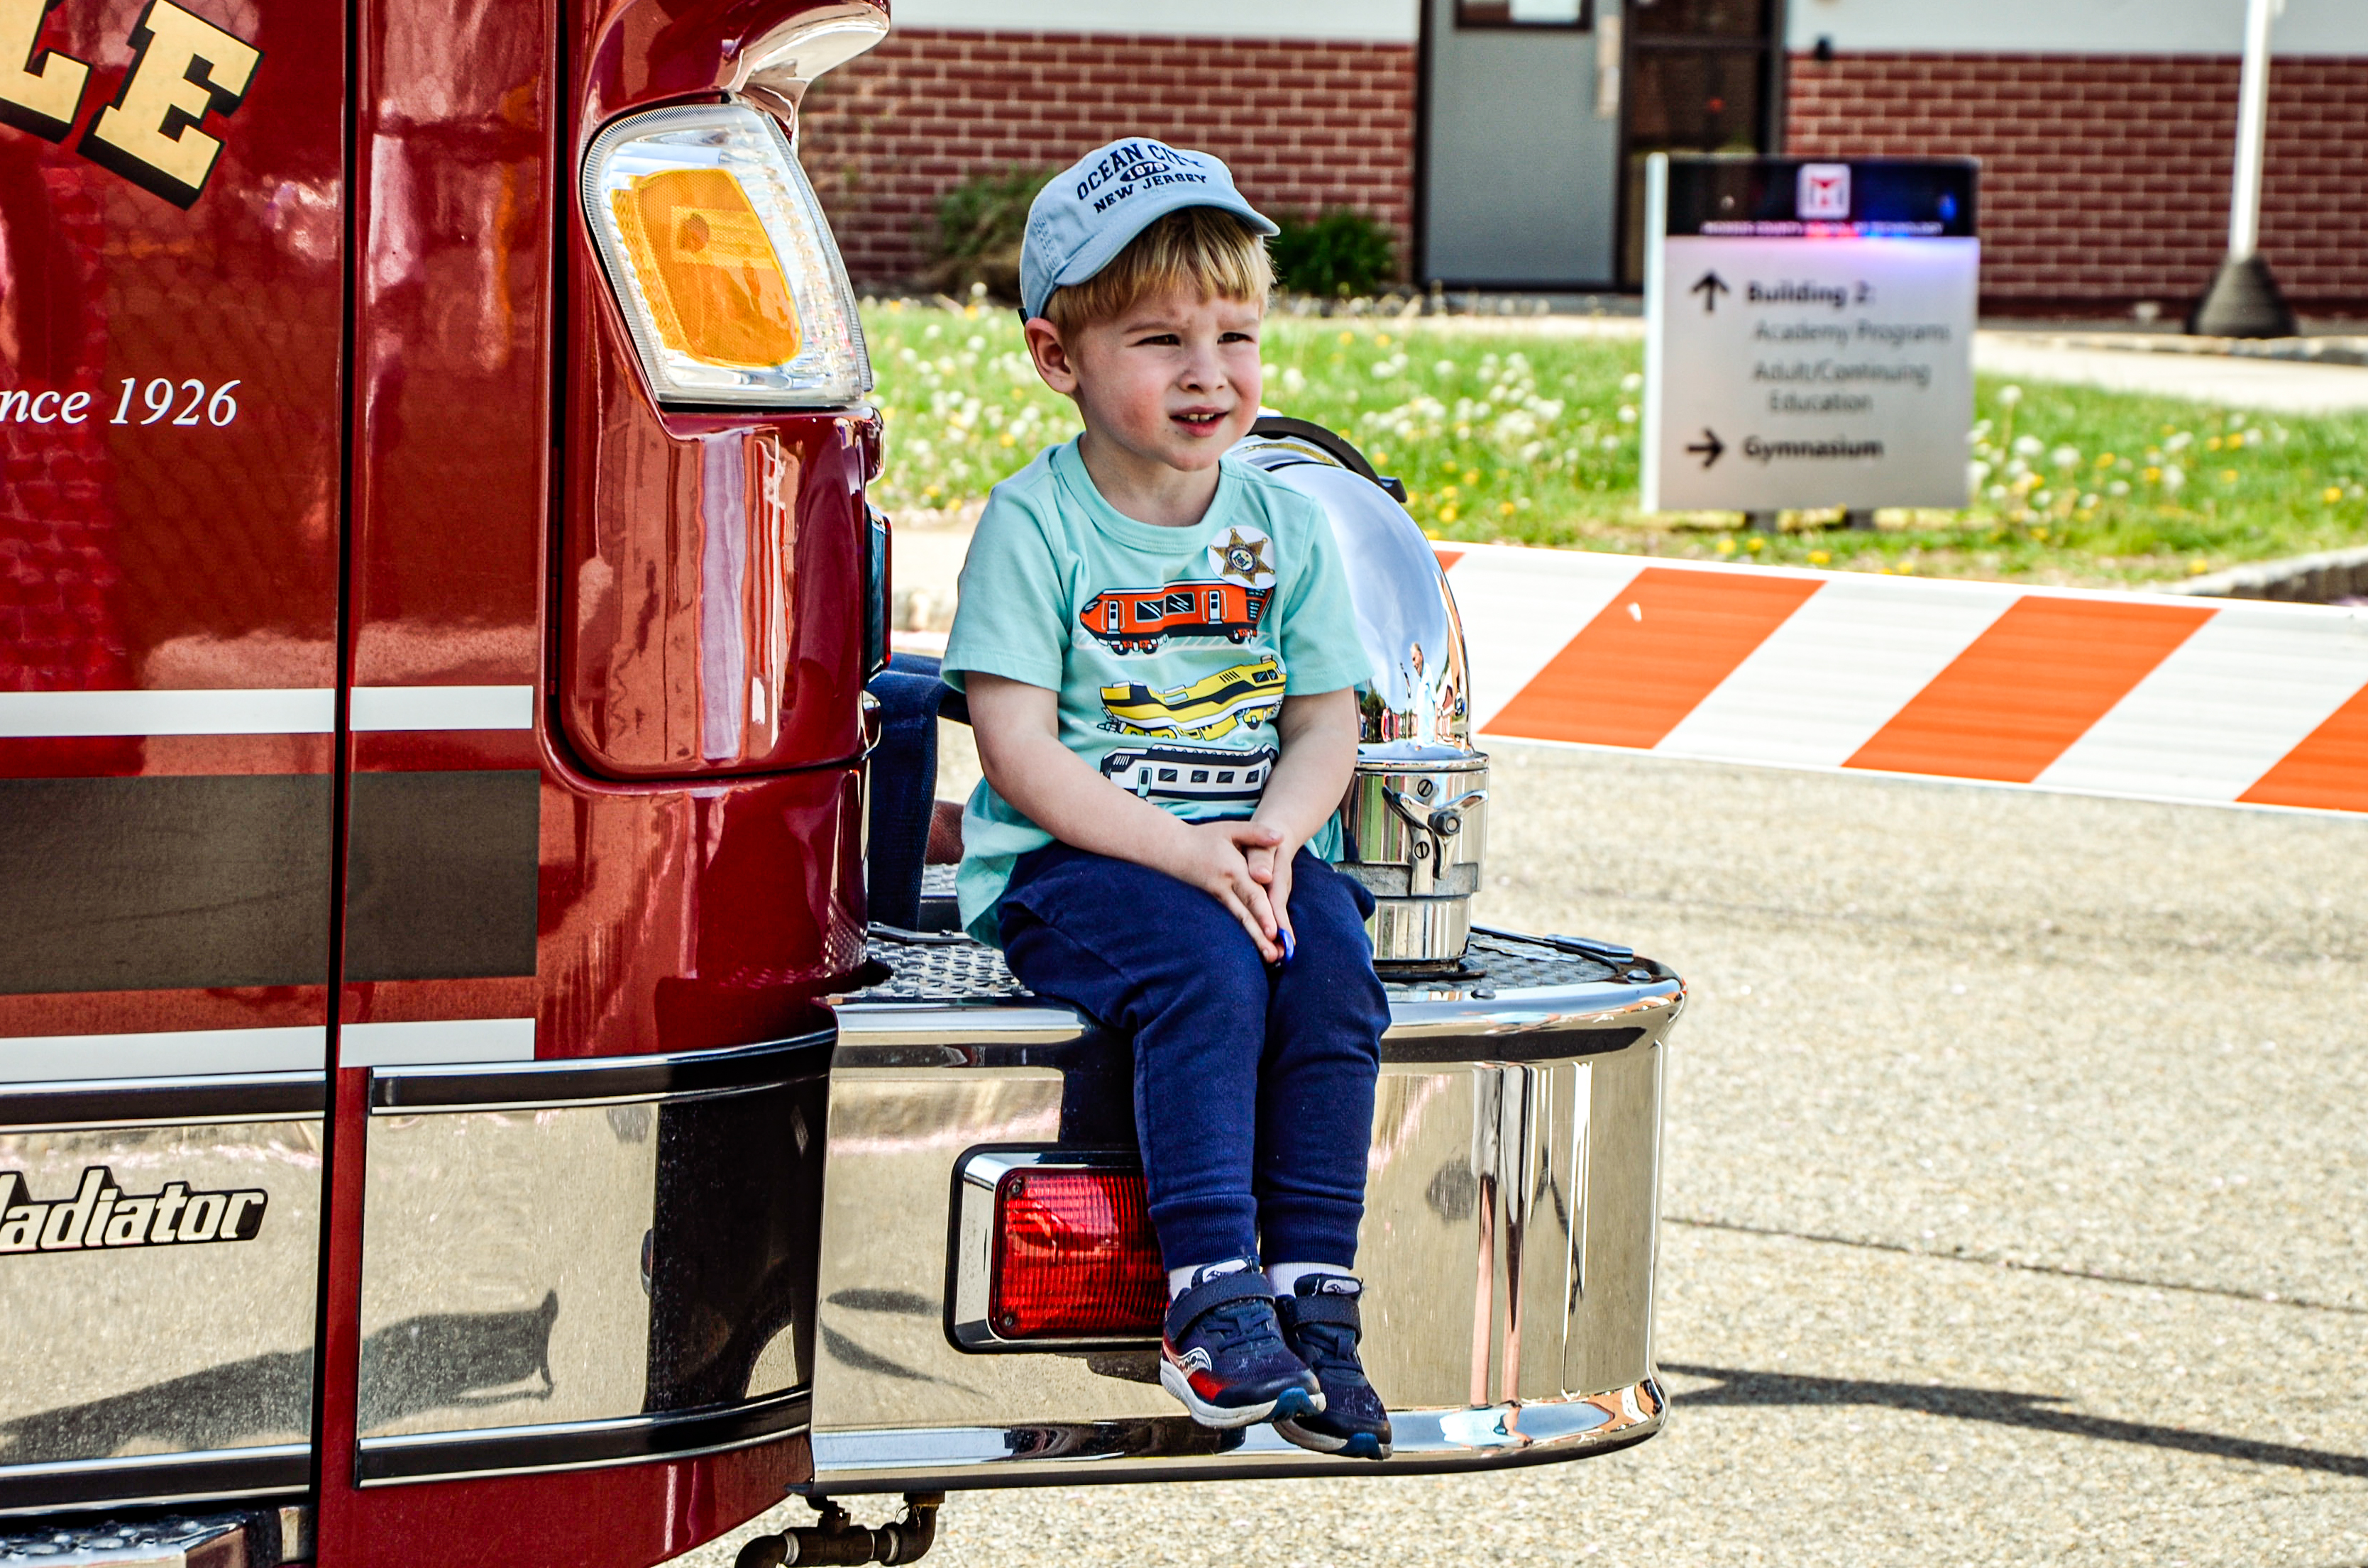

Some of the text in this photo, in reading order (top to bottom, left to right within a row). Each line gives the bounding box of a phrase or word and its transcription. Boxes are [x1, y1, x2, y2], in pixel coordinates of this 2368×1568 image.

[1076, 143, 1144, 200] OCEAN
[1125, 162, 1165, 178] 1879
[1093, 173, 1206, 214] NEW JERSEY
[1747, 281, 1846, 308] Building
[1755, 319, 1950, 346] Academy Programs
[1754, 358, 1932, 388] Adult/Continuing
[110, 377, 241, 426] 1926
[1771, 391, 1873, 412] Education
[1744, 435, 1883, 463] Gymnasium
